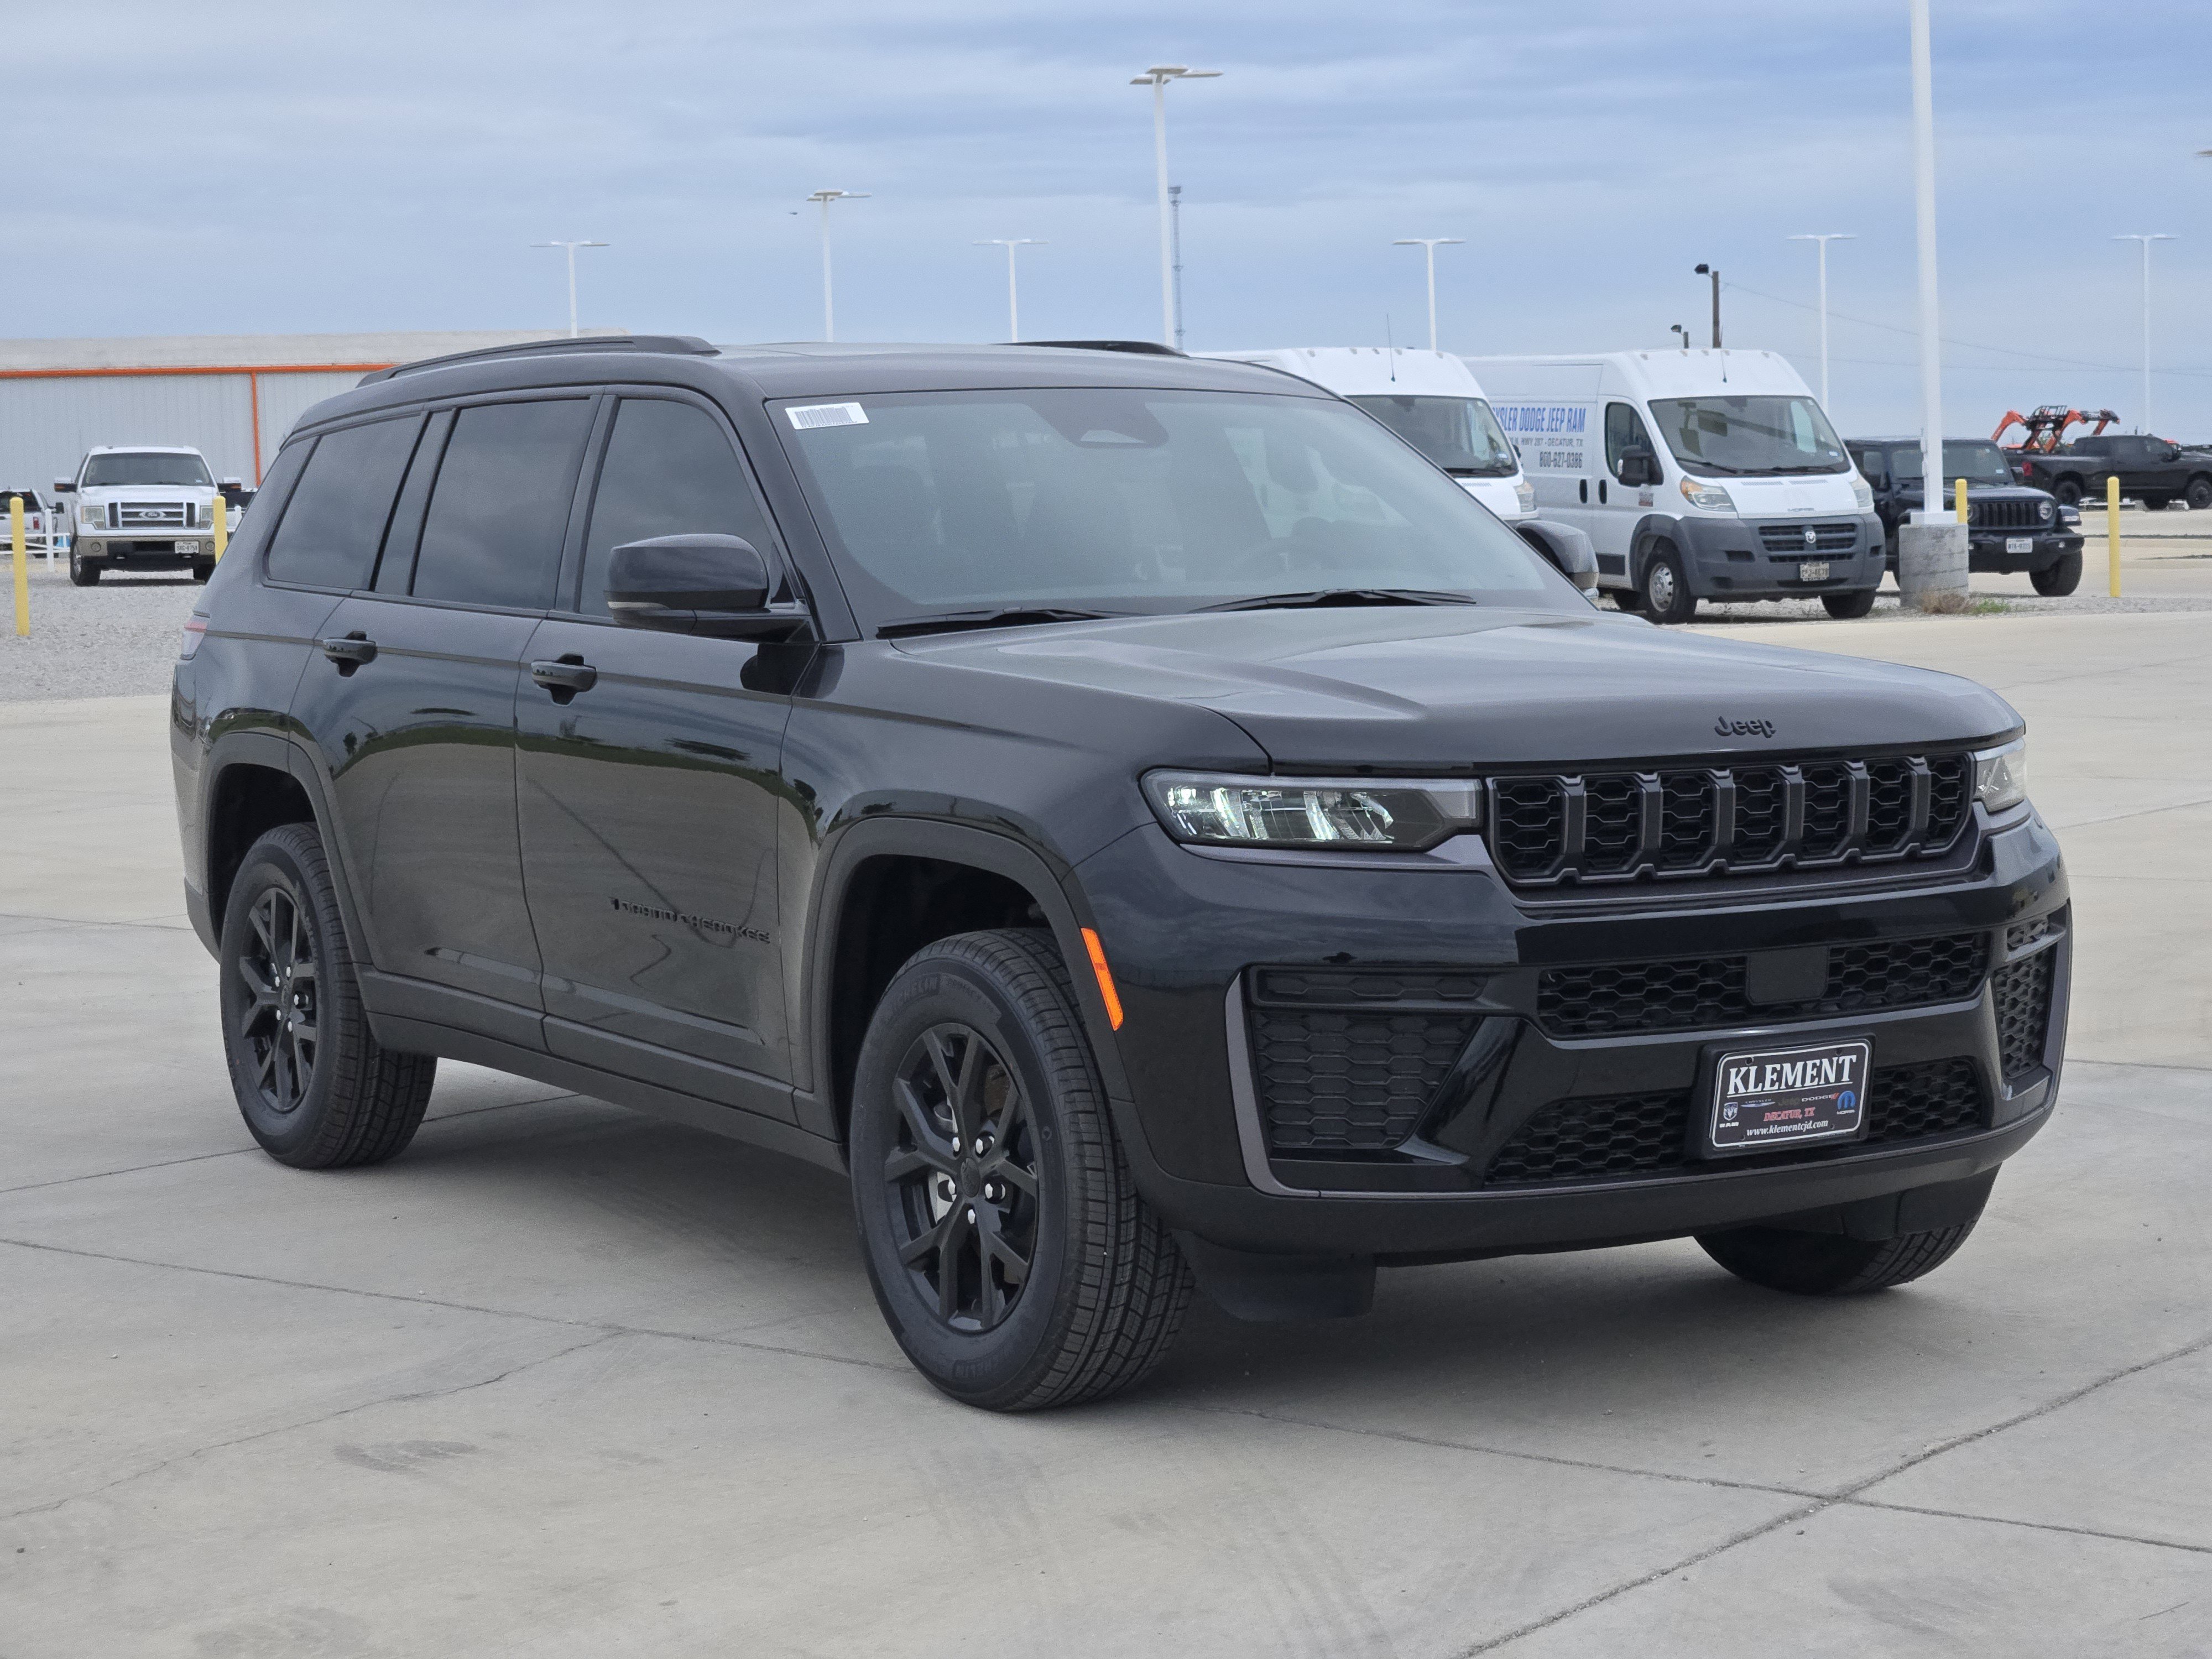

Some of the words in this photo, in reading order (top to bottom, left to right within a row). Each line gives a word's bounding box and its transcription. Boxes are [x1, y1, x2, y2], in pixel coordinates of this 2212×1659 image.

[1520, 407, 1546, 432] DODGE
[1547, 408, 1566, 432] JEEP
[1567, 408, 1586, 432] RAM
[1714, 716, 1776, 738] Jeep
[1727, 1055, 1857, 1095] KLEMENT
[1763, 1109, 1803, 1121] DECATUR,
[1804, 1107, 1816, 1117] TX
[1746, 1120, 1829, 1136] www.klementcjd.com
